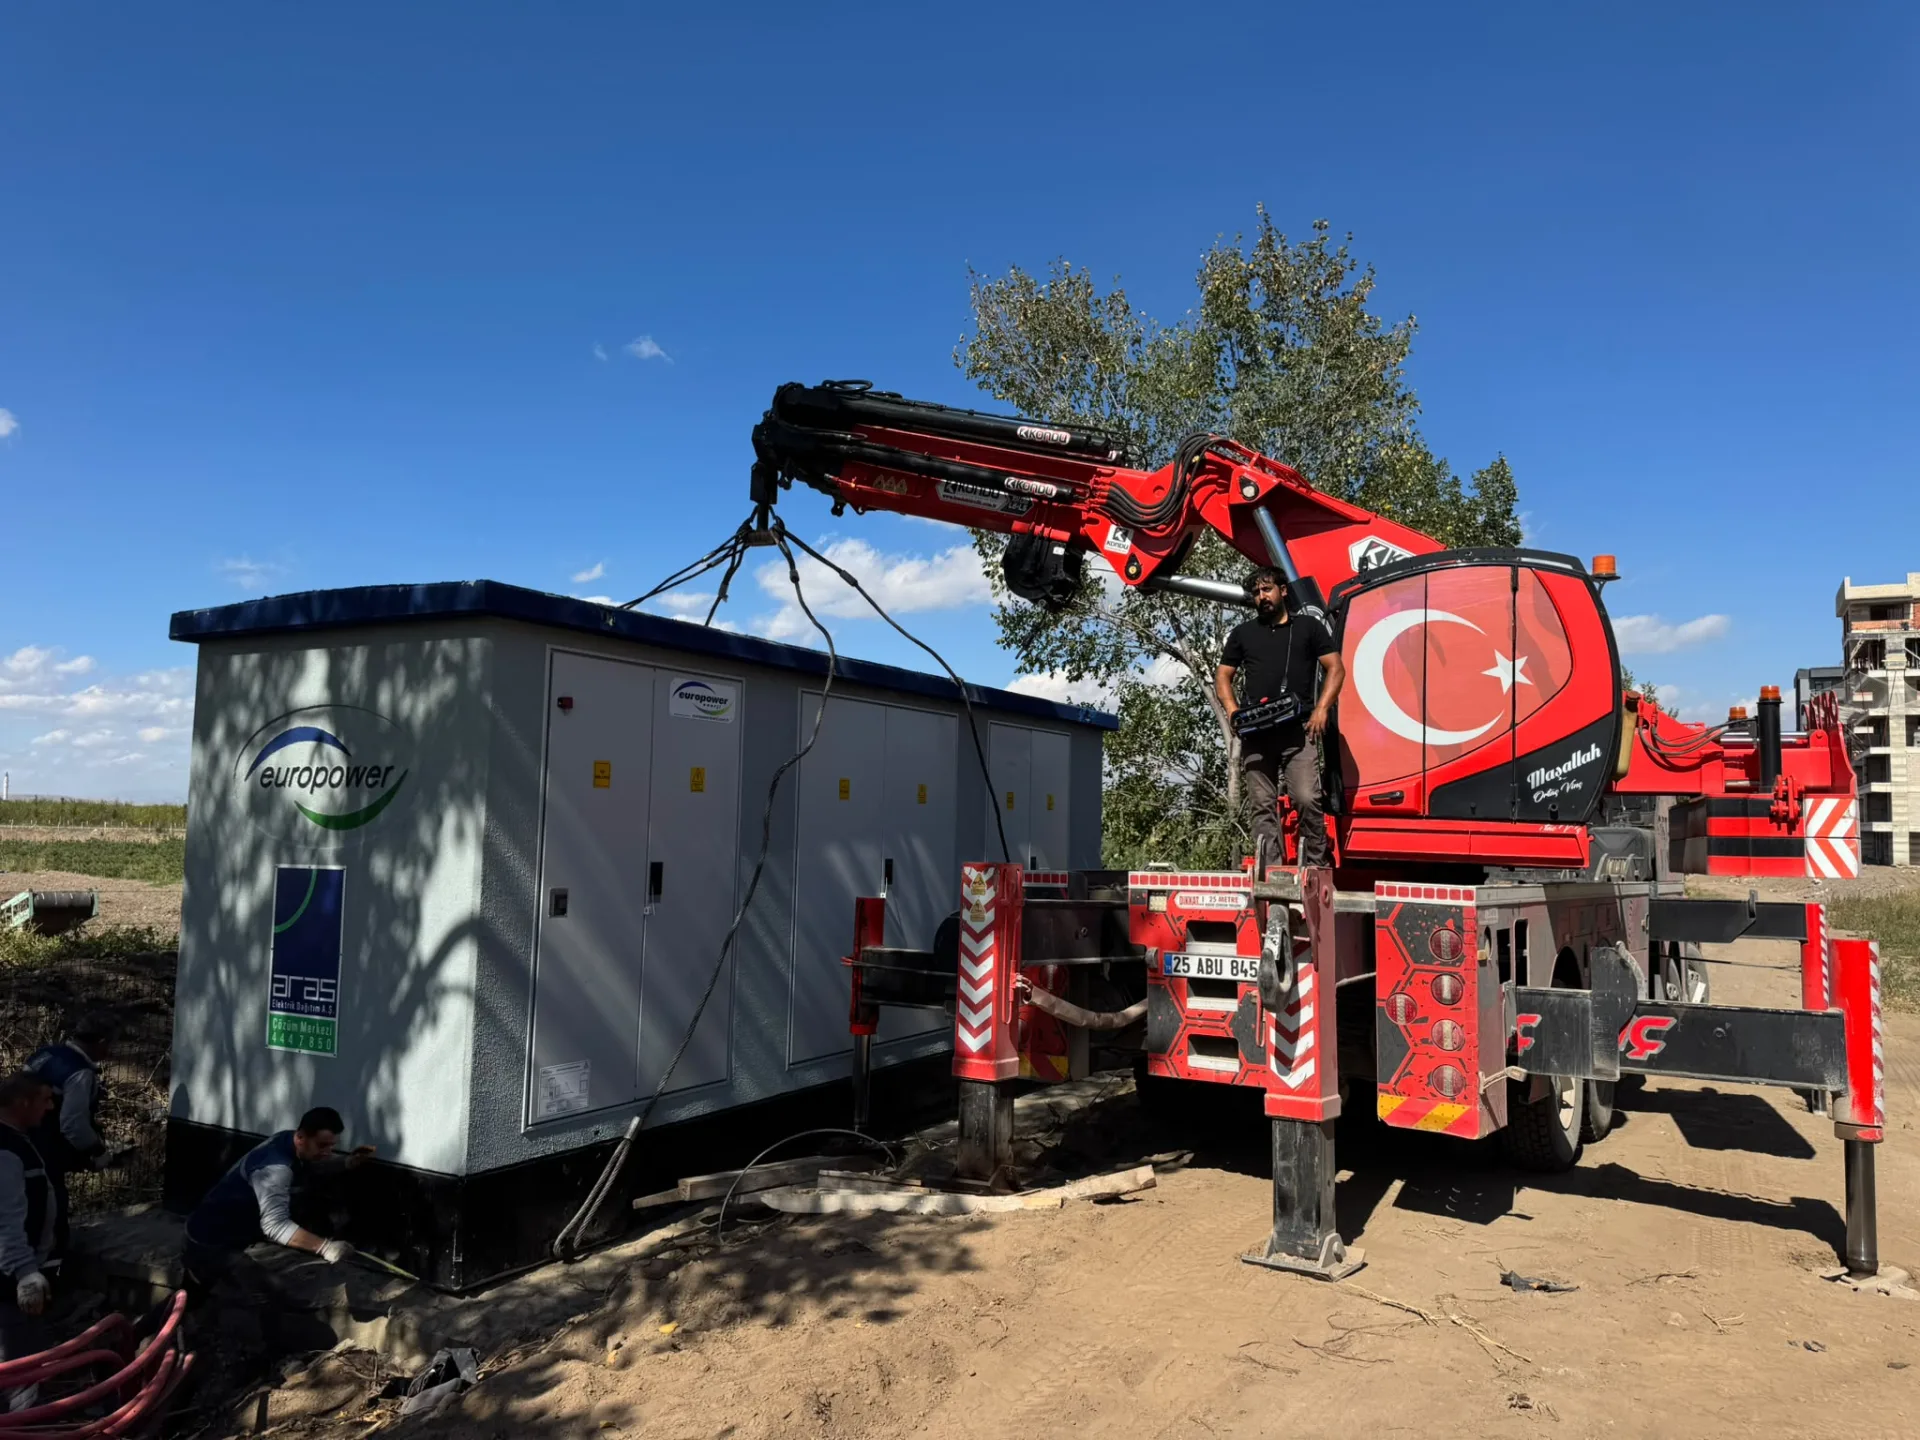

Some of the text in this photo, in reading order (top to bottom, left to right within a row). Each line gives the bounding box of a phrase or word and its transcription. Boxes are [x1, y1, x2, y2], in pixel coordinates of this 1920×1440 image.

[1029, 430, 1068, 443] KONDU
[1016, 480, 1055, 496] KONDU
[678, 691, 729, 705] europower
[260, 765, 395, 795] europower
[1173, 956, 1258, 978] 25 ABU 845
[272, 974, 336, 1003] aras
[271, 999, 295, 1010] Elektrik
[272, 1017, 332, 1036] Çözüm Merkezi
